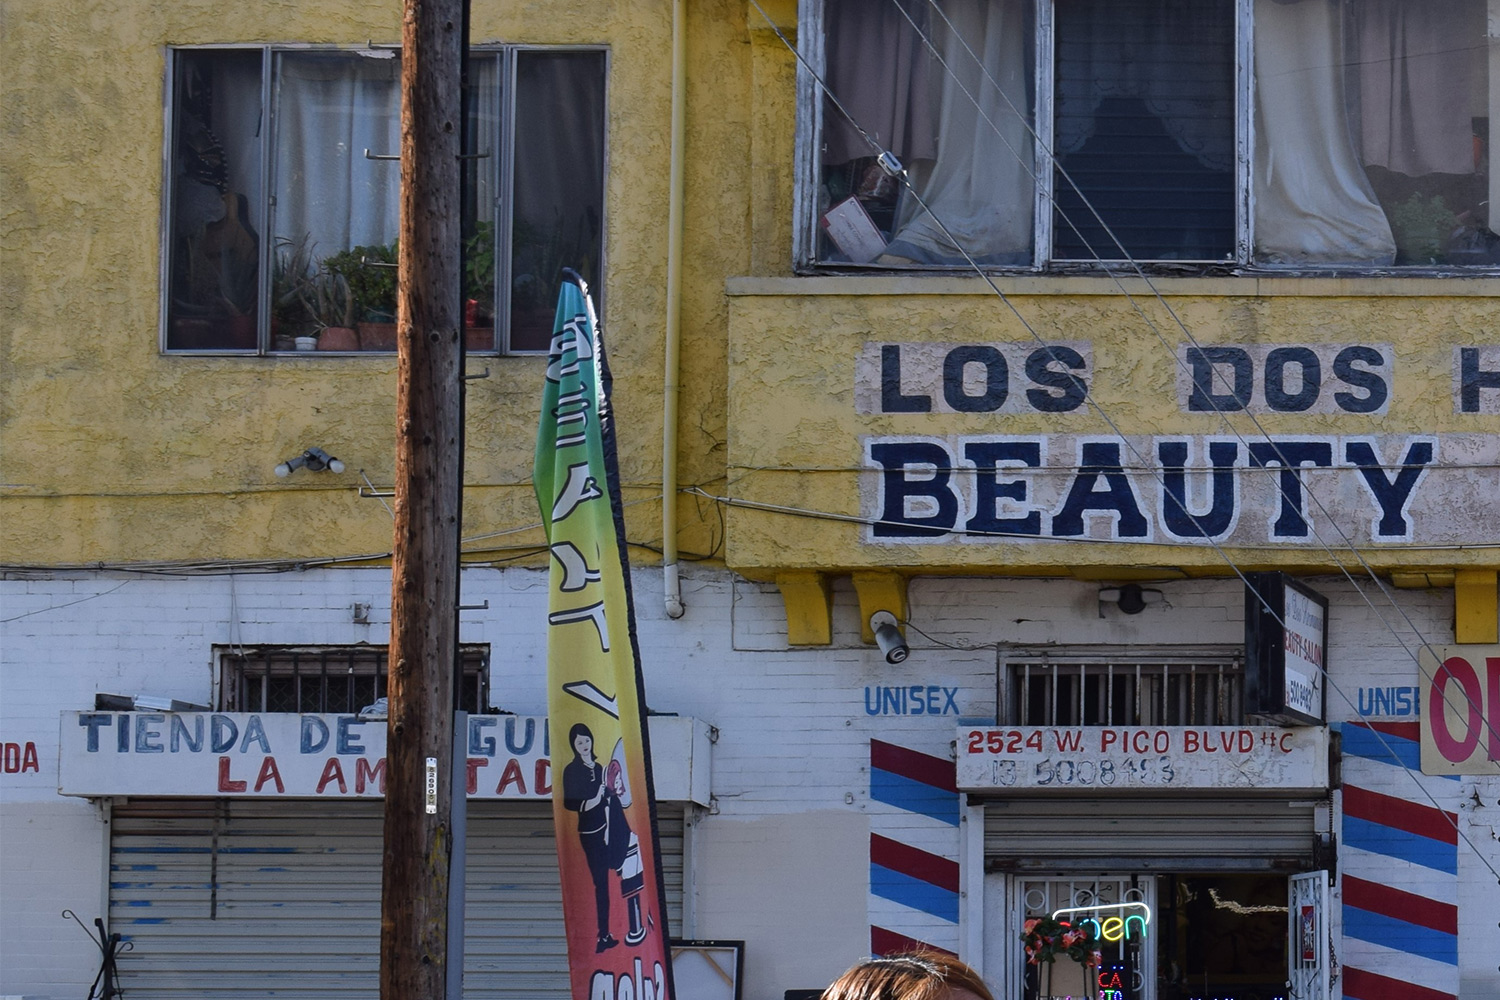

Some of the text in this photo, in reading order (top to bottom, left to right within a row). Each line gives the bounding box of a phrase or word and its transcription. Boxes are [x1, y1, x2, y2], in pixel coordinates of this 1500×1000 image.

[881, 344, 1089, 413] LOS
[1186, 346, 1388, 413] DOS
[868, 440, 1435, 539] BEAUTY
[1284, 628, 1302, 658] EAUTY
[864, 685, 960, 716] UNISEX
[78, 713, 366, 756] TIENDA DE
[967, 729, 1043, 754] 2524
[1053, 729, 1085, 753] W.
[1100, 729, 1170, 753] PICO
[1183, 729, 1254, 754] BLVD
[217, 756, 285, 794] LA
